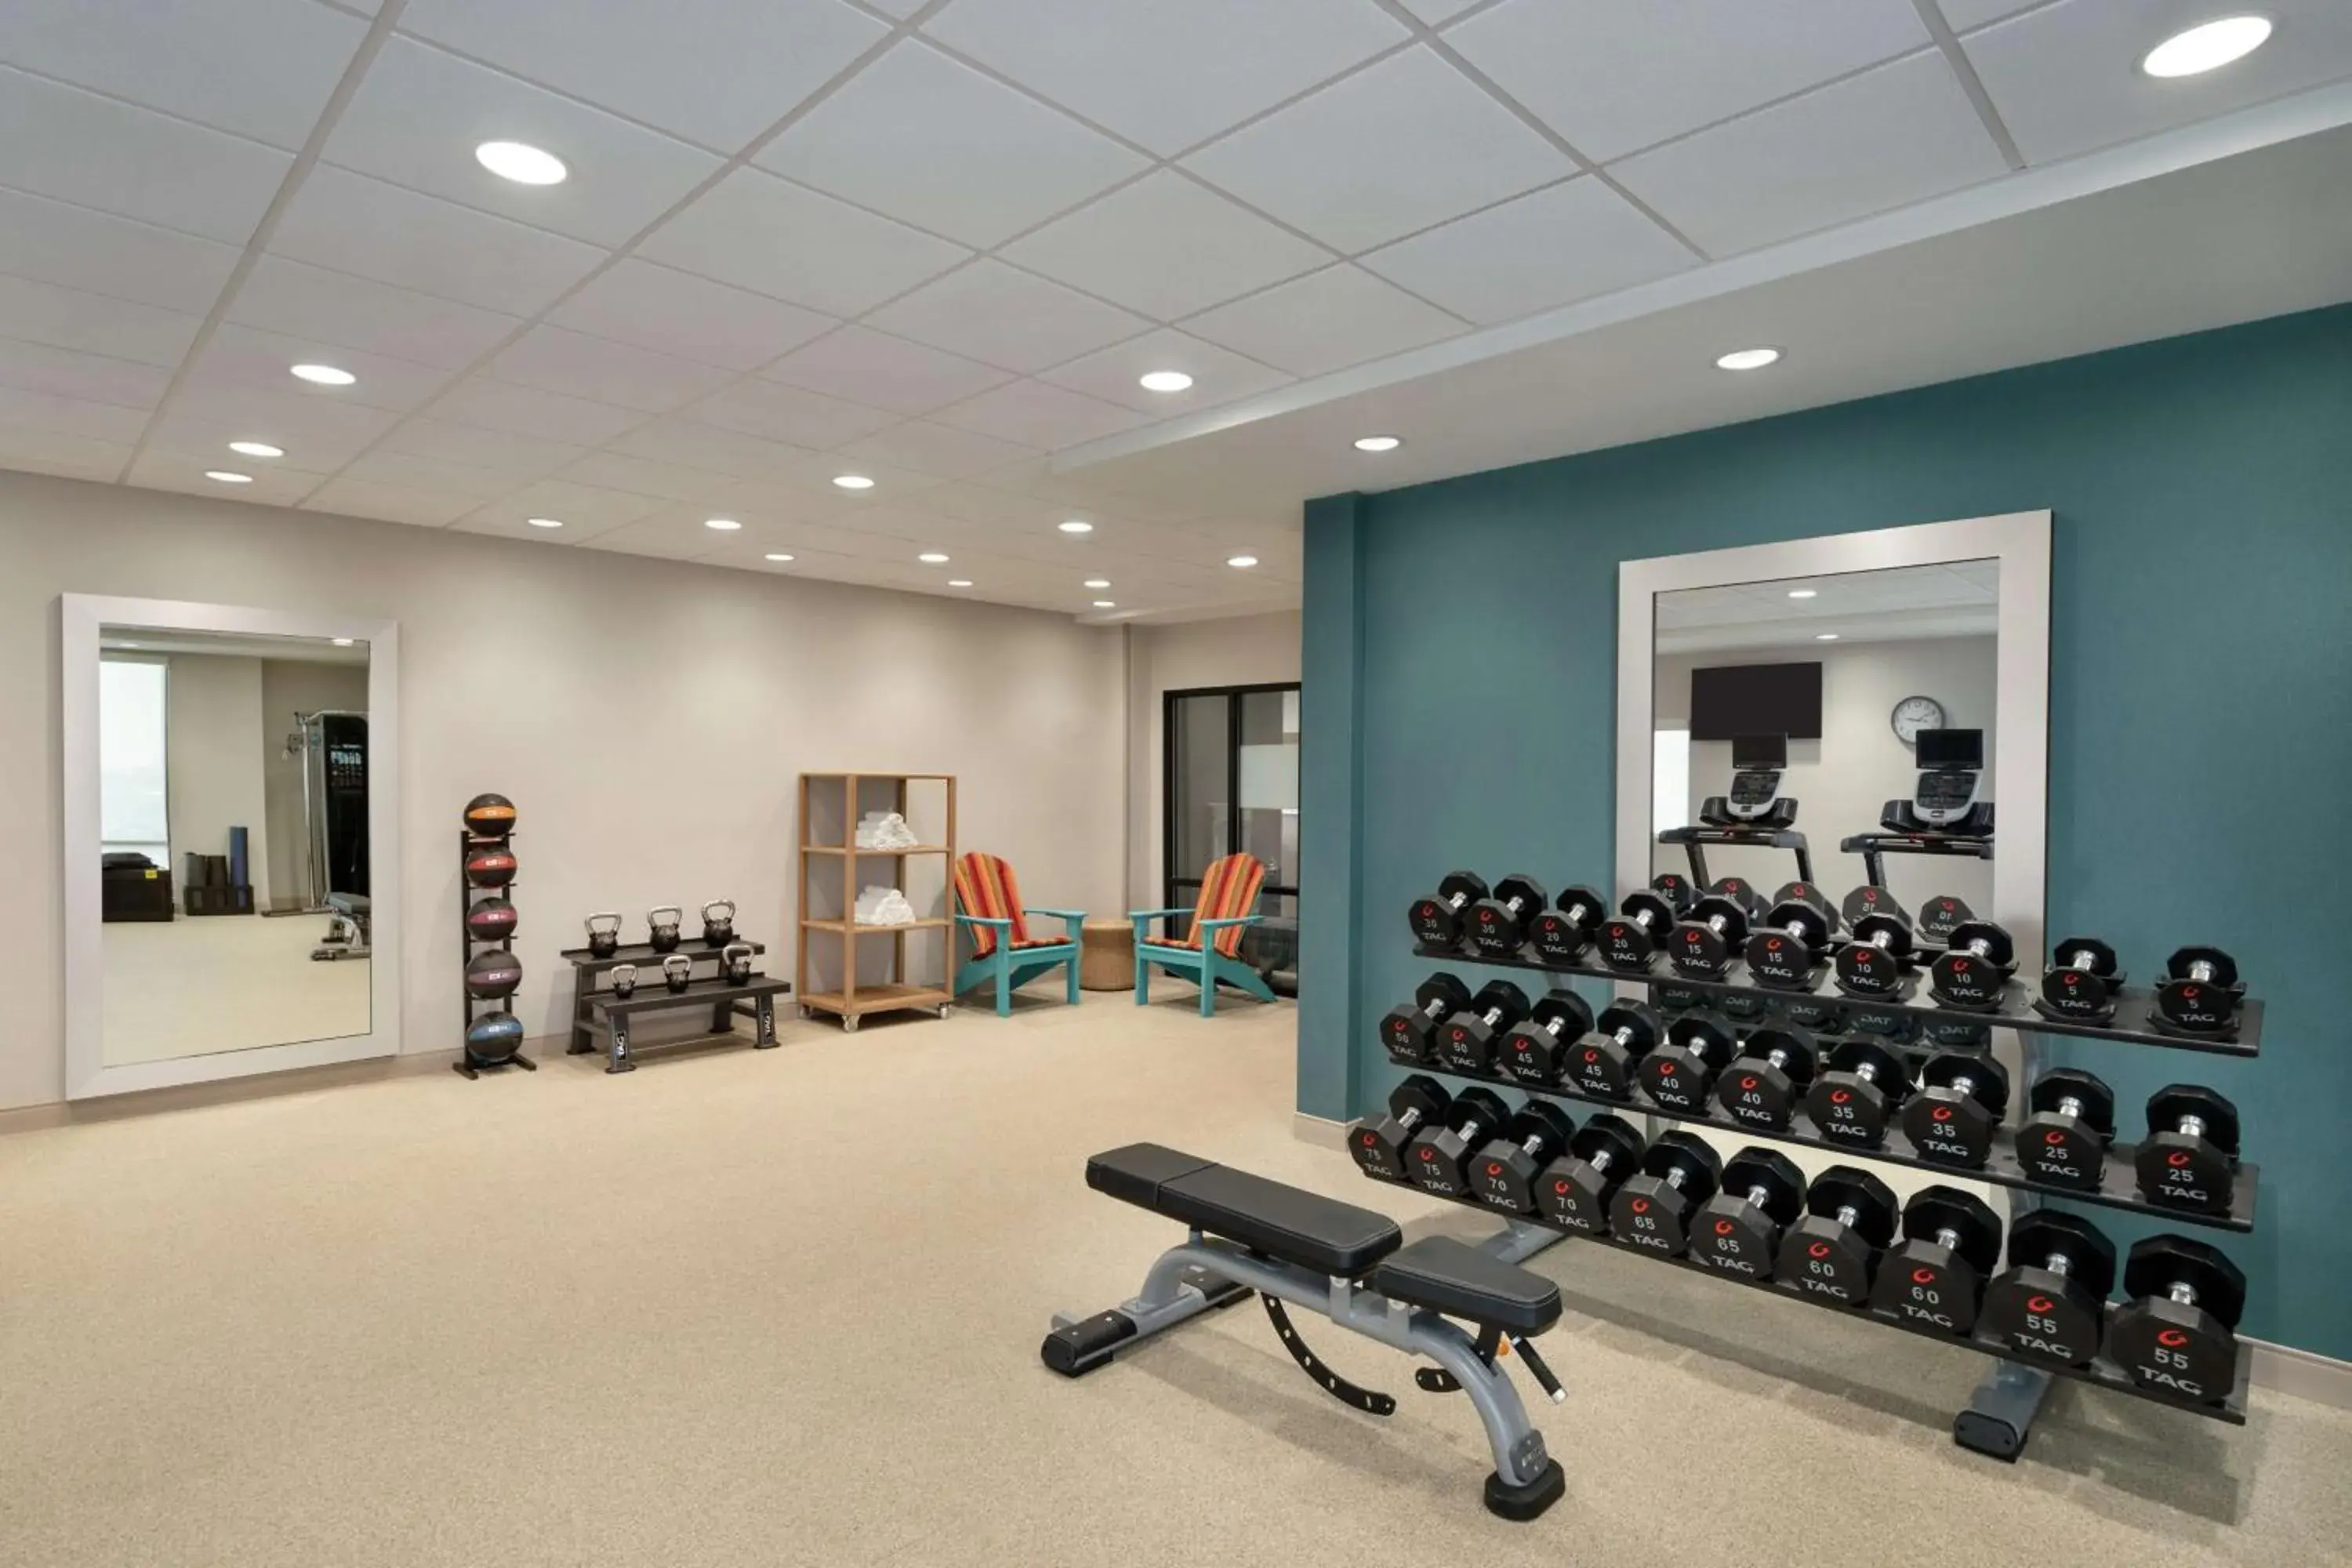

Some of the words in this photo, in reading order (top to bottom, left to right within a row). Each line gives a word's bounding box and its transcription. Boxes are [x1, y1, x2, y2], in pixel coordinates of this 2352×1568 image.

[1542, 945, 1568, 954] TAG
[1688, 945, 1701, 955] 15
[1610, 953, 1637, 962] TAG
[1682, 957, 1711, 968] TAG
[1768, 953, 1782, 963] 15
[1760, 965, 1794, 977] TAG
[1857, 964, 1871, 974] 10
[1850, 975, 1881, 986] TAG
[1956, 973, 1971, 983] 10
[1948, 987, 1983, 997] TAG
[2069, 986, 2077, 996] 5
[2058, 1000, 2092, 1009] TAG
[2177, 1014, 2216, 1022] TAG
[1454, 1043, 1468, 1054] 50
[1451, 1057, 1477, 1067] TAG
[1518, 1052, 1533, 1063] 45
[1515, 1066, 1542, 1078] TAG
[1586, 1065, 1602, 1076] 45
[1580, 1078, 1611, 1091] TAG
[1661, 1077, 1679, 1090] 40
[1656, 1091, 1689, 1105] TAG
[1742, 1092, 1761, 1105] 40
[1734, 1106, 1772, 1123] TAG
[1833, 1105, 1854, 1119] 35
[1825, 1122, 1867, 1137] TAG
[1933, 1123, 1956, 1137] 35
[1923, 1139, 1969, 1157] TAG
[2045, 1147, 2068, 1160] 25
[1363, 1163, 1392, 1177] TAG
[1423, 1163, 1440, 1176] 75
[2036, 1161, 2080, 1177] TAG
[2169, 1169, 2194, 1181] 25
[1421, 1179, 1453, 1192] TAG
[1489, 1177, 1507, 1191] 70
[2158, 1185, 2209, 1202] TAG
[1485, 1192, 1518, 1210] TAG
[1556, 1196, 1577, 1210] 70
[1555, 1214, 1590, 1229] TAG
[1634, 1216, 1656, 1230] 65
[1630, 1233, 1669, 1249] TAG
[1717, 1238, 1740, 1254] 65
[1711, 1254, 1755, 1274] TAG
[1809, 1261, 1835, 1277] 60
[1802, 1276, 1849, 1299] TAG
[1911, 1286, 1940, 1305] 60
[1901, 1304, 1955, 1328] TAG
[2026, 1313, 2058, 1334] 55
[2015, 1333, 2074, 1359] TAG
[2154, 1348, 2190, 1370] 55
[2137, 1365, 2204, 1396] TAG
